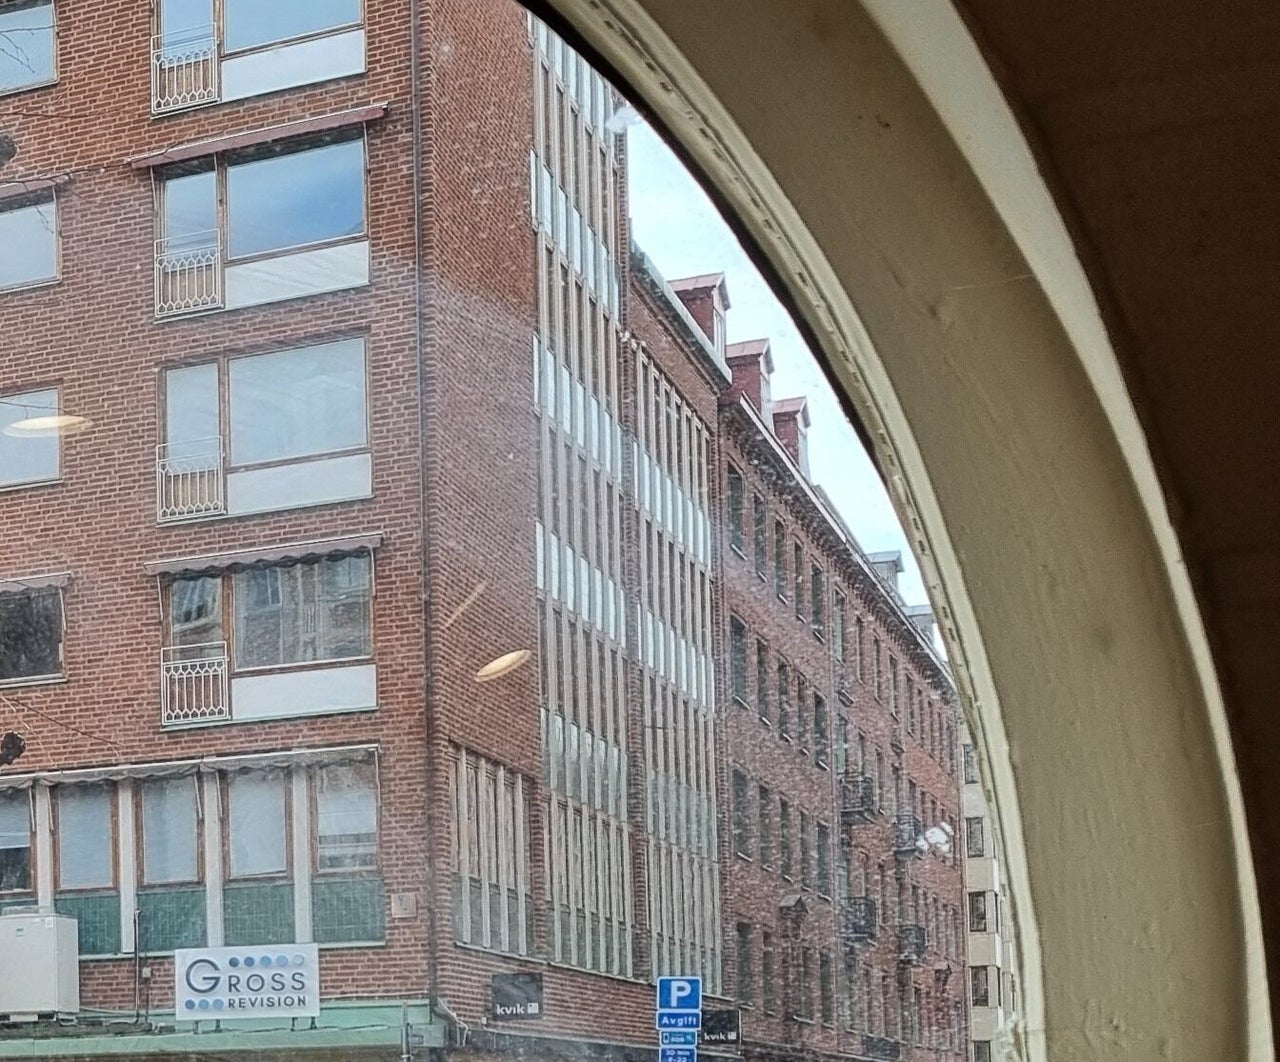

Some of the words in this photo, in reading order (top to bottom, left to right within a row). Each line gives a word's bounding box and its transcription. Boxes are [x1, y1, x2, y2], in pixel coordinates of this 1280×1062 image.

[670, 980, 692, 1007] P
[228, 996, 306, 1009] REVISION
[661, 1016, 697, 1026] Avgift
